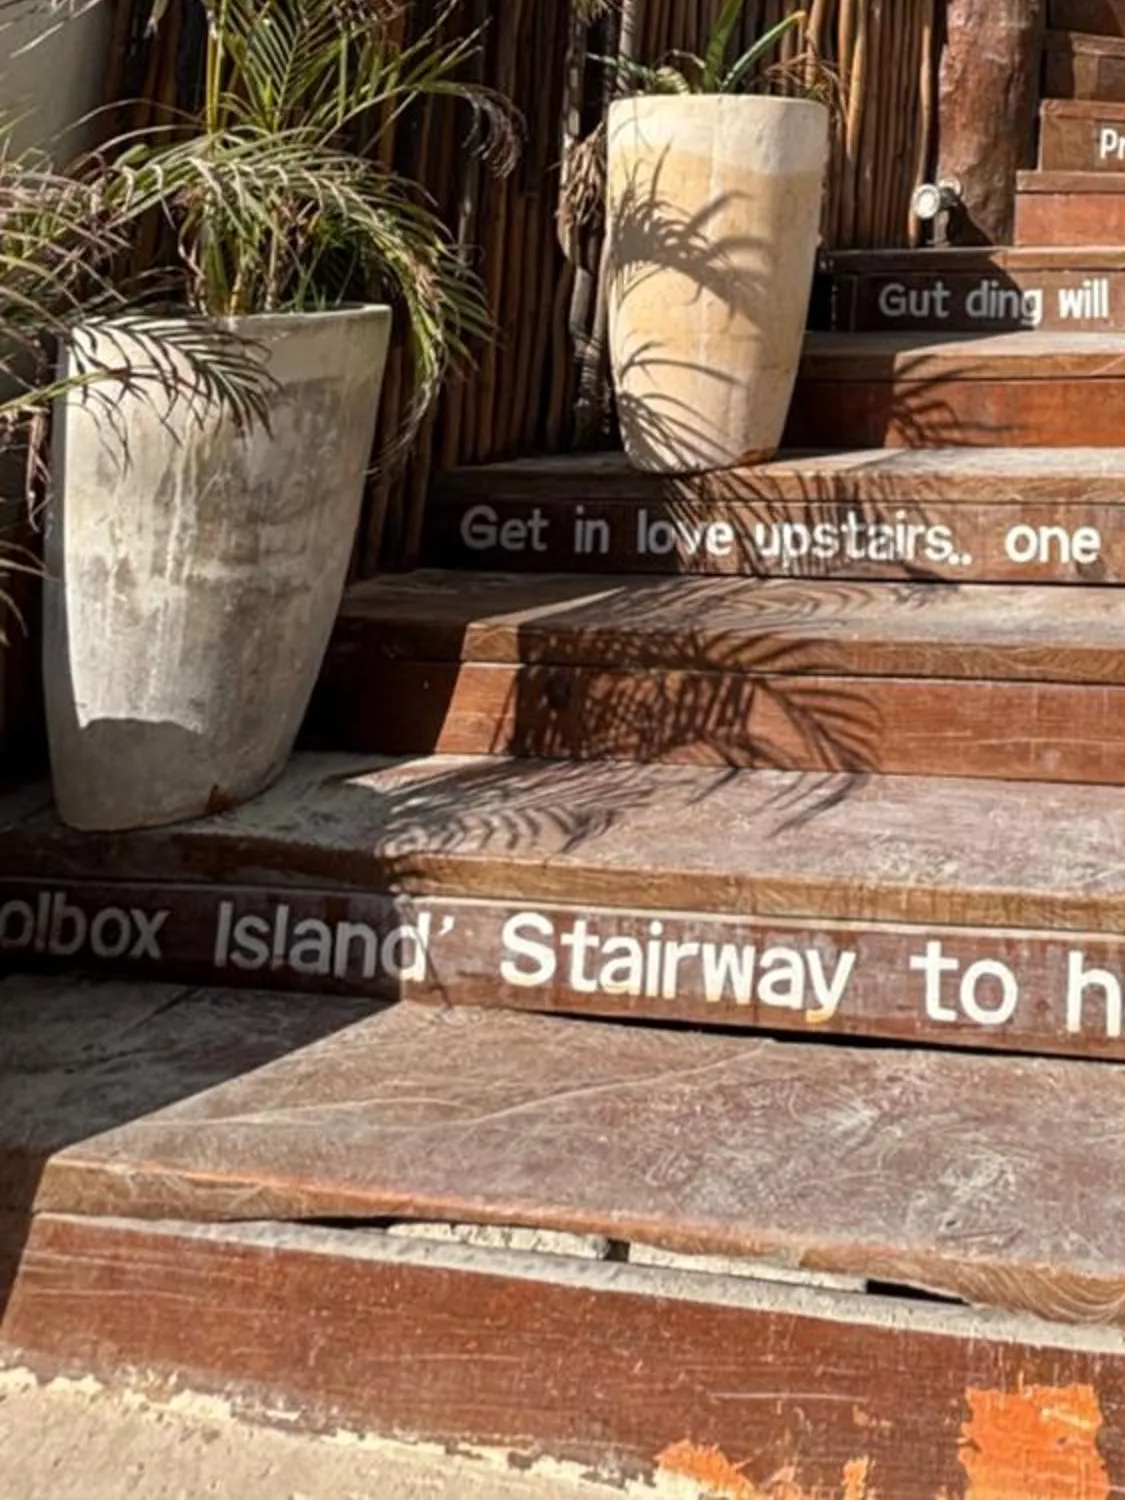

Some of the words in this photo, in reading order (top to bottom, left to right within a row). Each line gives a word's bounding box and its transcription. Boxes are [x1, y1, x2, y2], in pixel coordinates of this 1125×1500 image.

[878, 282, 951, 319] Gut
[966, 279, 1043, 324] ding
[1058, 280, 1110, 319] will
[460, 504, 548, 551] Get
[574, 504, 610, 553] in
[638, 510, 735, 556] love
[1004, 523, 1101, 564] one
[499, 911, 857, 1024] Stairway
[909, 939, 1019, 1026] to
